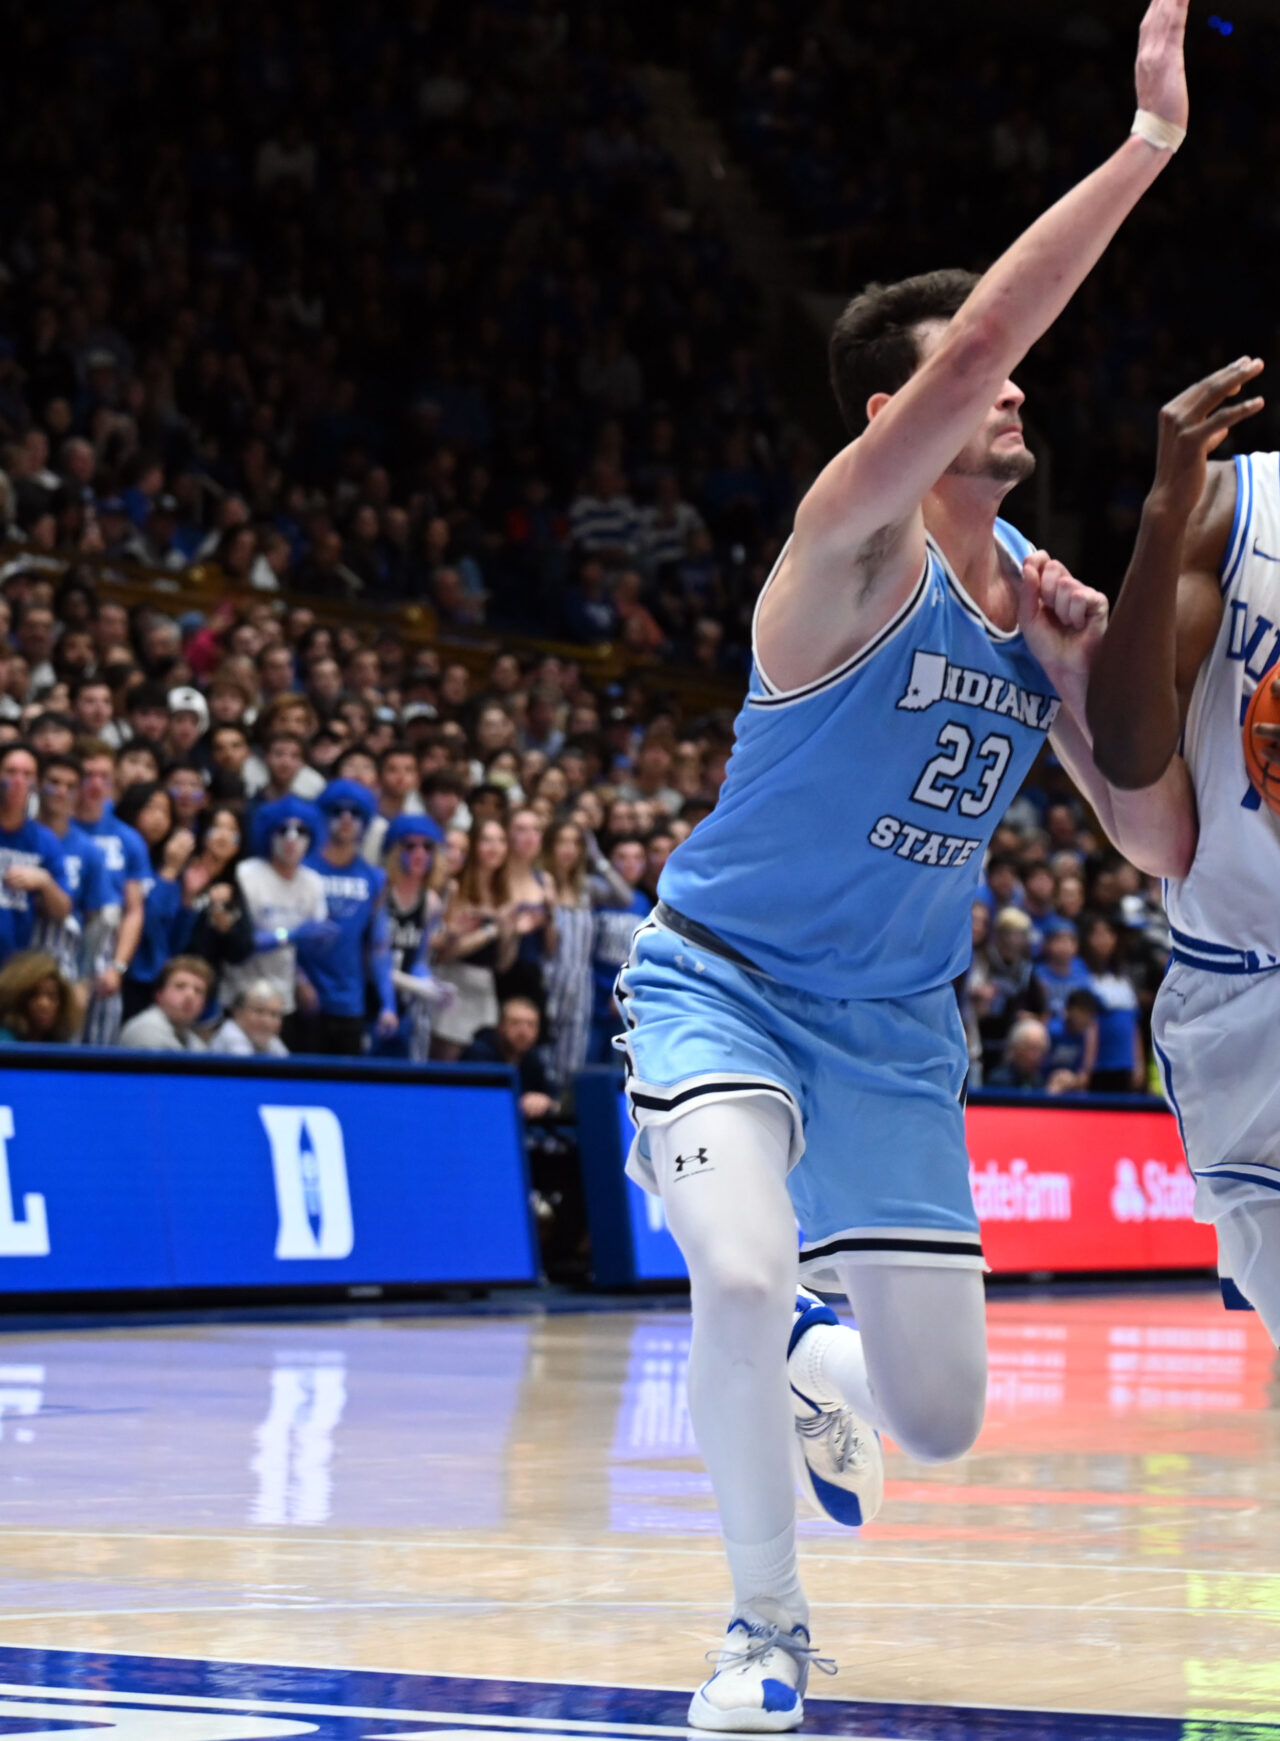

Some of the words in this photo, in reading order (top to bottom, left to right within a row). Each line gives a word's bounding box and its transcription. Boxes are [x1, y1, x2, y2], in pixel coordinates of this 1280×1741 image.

[909, 720, 1014, 818] 23
[868, 814, 982, 868] STATE
[257, 1103, 355, 1261] D
